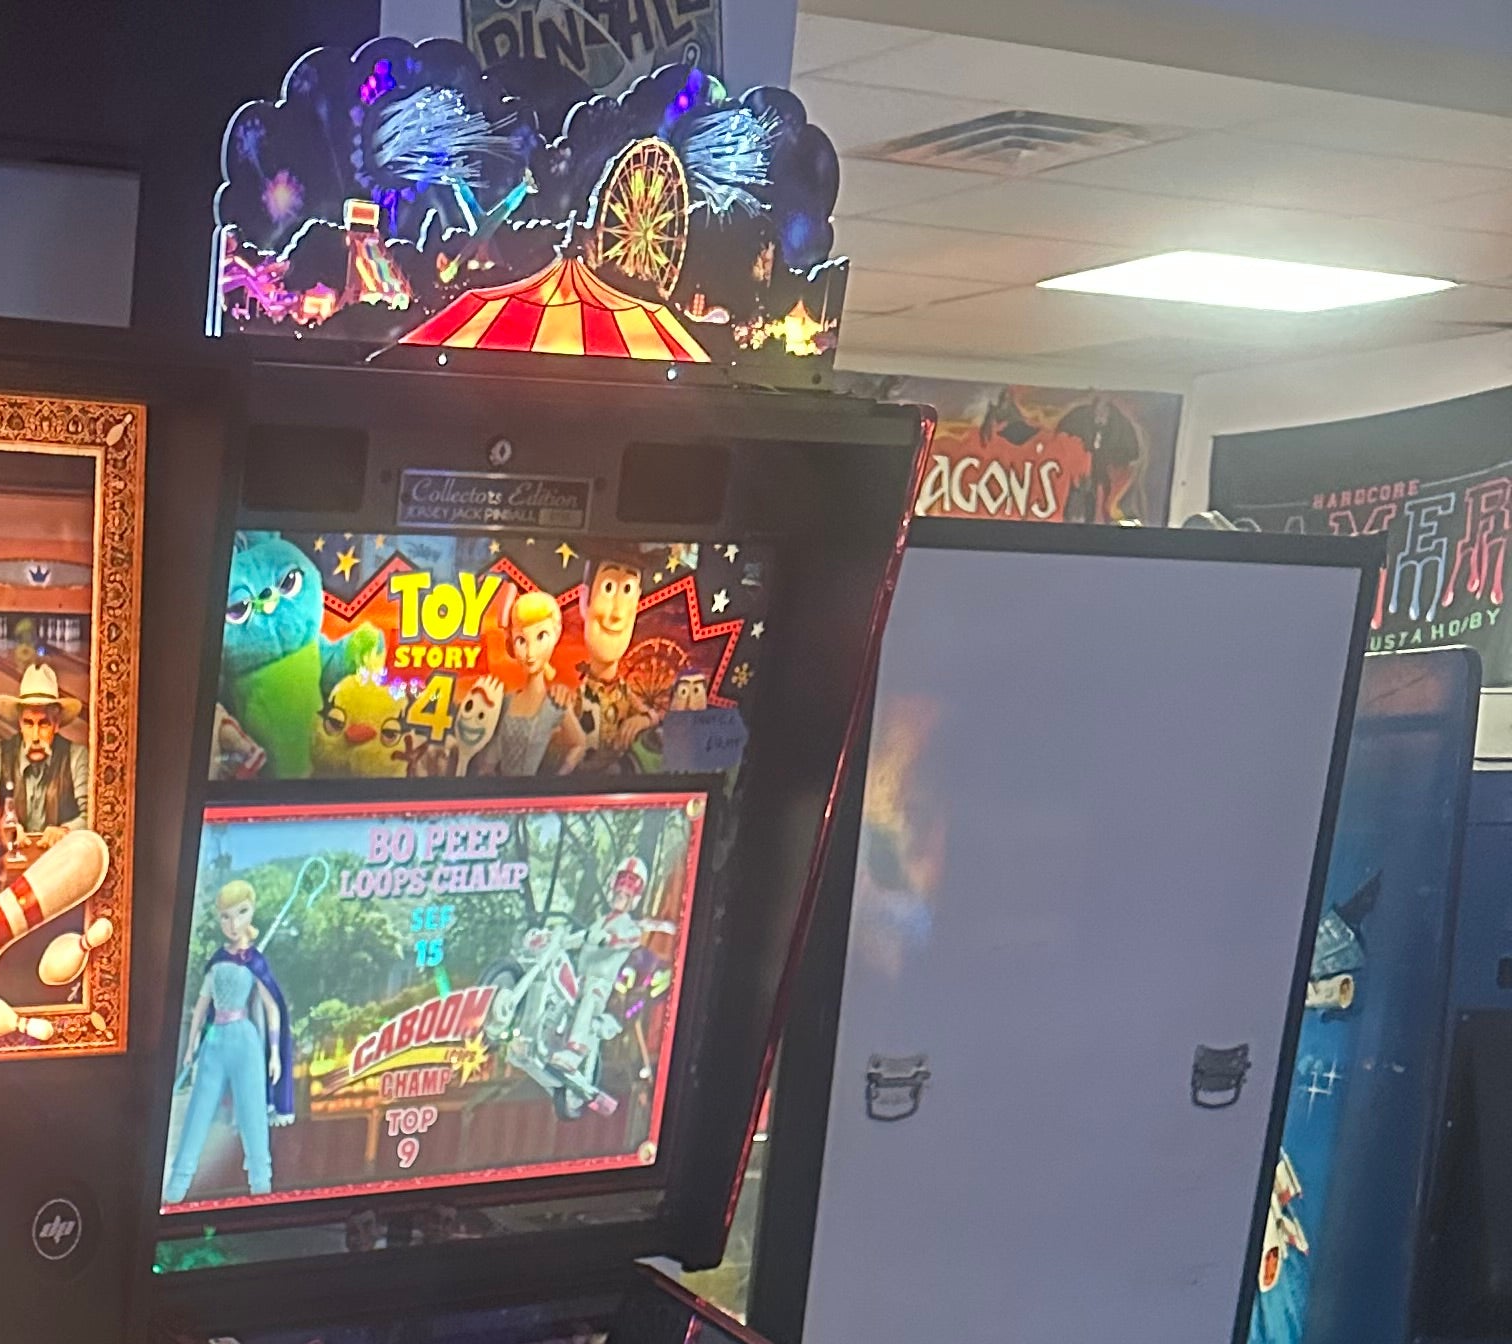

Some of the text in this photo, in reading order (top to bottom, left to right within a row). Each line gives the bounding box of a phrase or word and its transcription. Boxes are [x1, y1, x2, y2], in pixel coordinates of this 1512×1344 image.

[508, 482, 578, 508] Edition
[1312, 479, 1420, 509] HARDCORE
[451, 506, 482, 521] JACK
[389, 571, 500, 642] TOY
[394, 642, 483, 670] STORY
[407, 672, 457, 742] 4
[368, 822, 511, 864] BO PEEP
[339, 861, 528, 900] LOOPS CHAMP
[414, 938, 444, 968] 15
[349, 985, 498, 1077] CABOOM
[381, 1069, 453, 1100] CHAMP
[386, 1106, 437, 1137] TOP
[397, 1138, 419, 1169] 9
